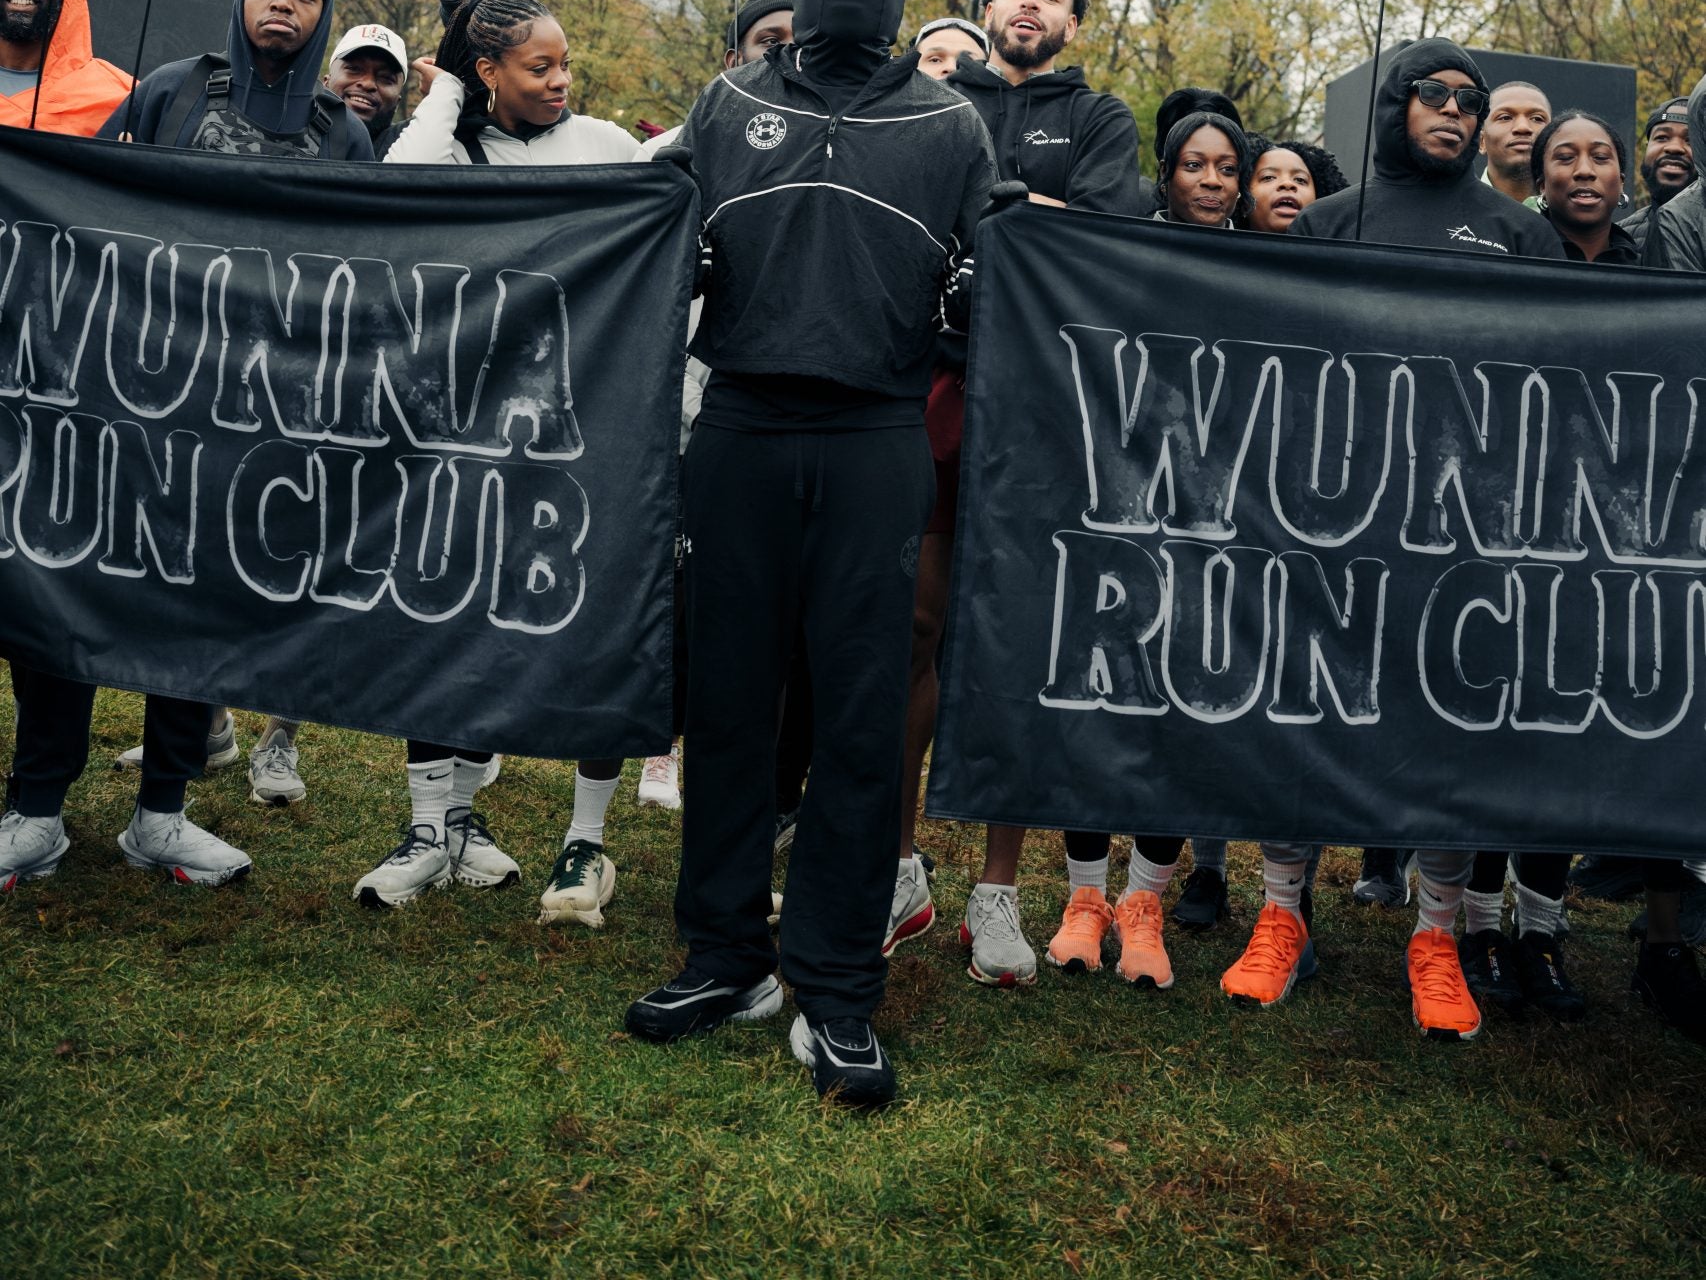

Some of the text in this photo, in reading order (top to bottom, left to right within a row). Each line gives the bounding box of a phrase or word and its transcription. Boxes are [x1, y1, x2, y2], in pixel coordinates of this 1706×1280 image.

[748, 128, 785, 148] PERFORMANCE
[1458, 235, 1477, 243] PEAK
[0, 400, 589, 634] UN CLUB
[1038, 530, 1706, 739] RUN CLU
